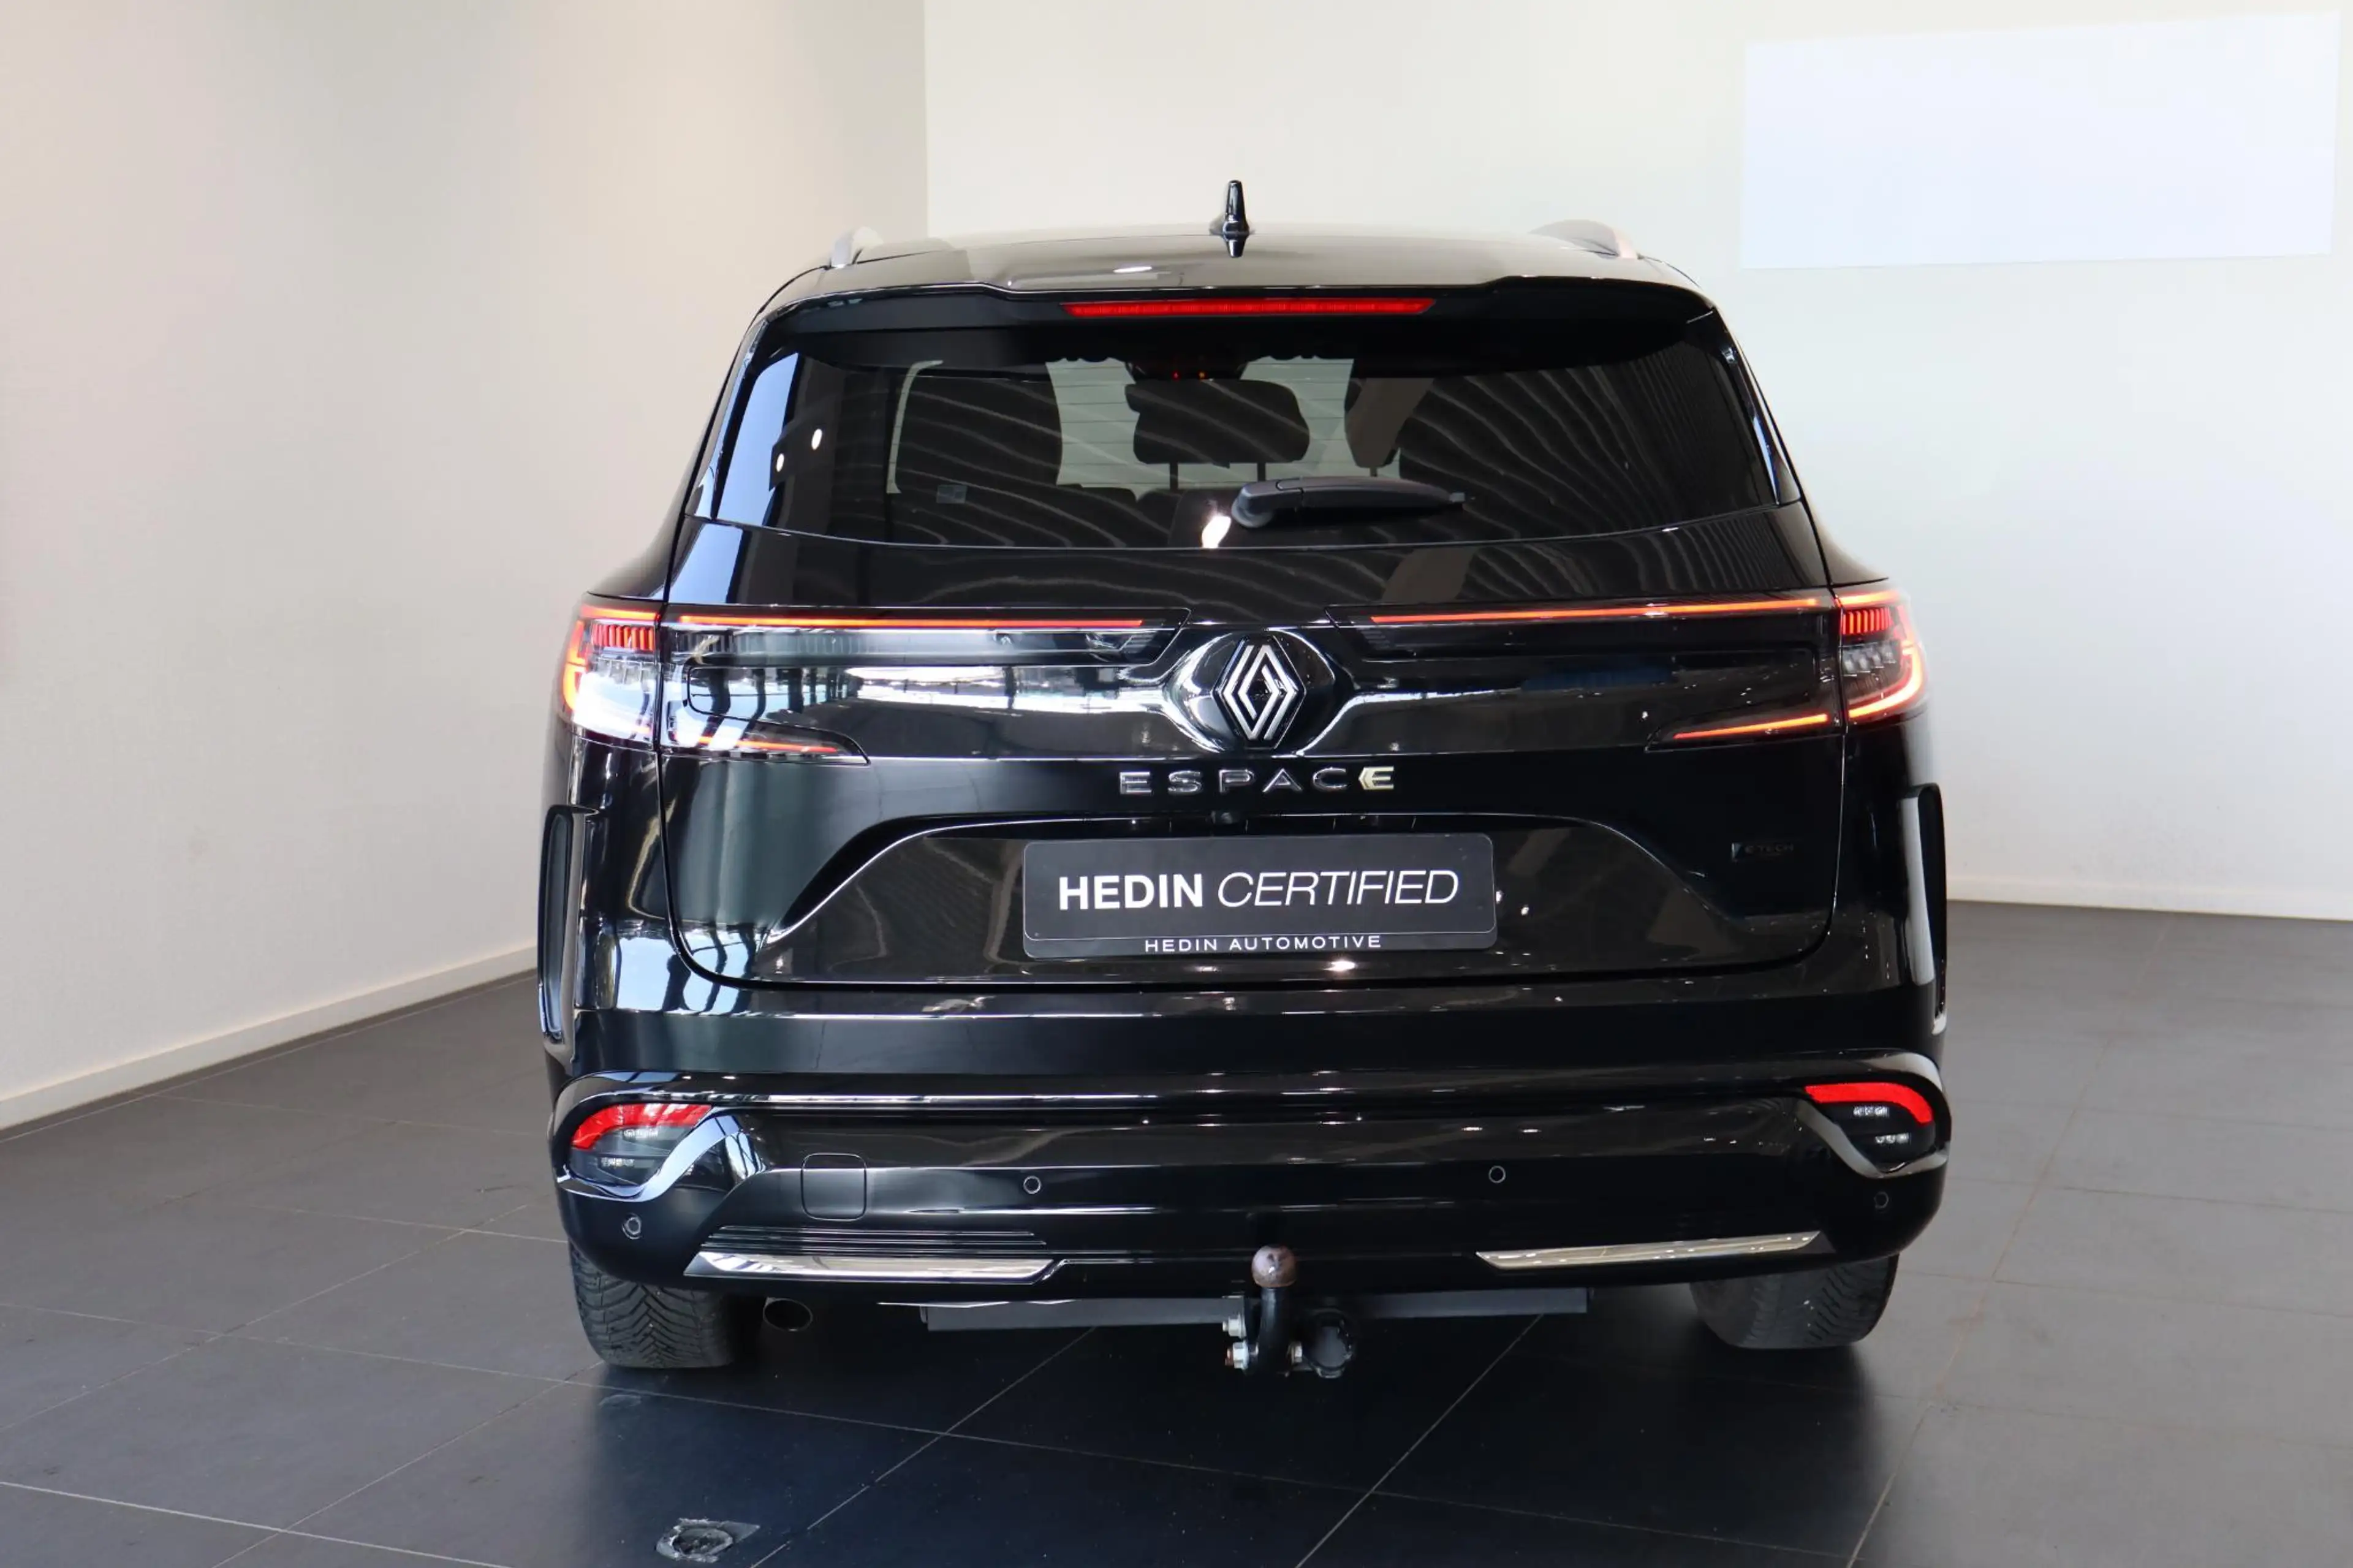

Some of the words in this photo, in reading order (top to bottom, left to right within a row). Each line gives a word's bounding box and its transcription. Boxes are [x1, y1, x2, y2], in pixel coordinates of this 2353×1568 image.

[1120, 767, 1395, 795] ESPACE
[1059, 873, 1203, 911] HEDIN
[1218, 869, 1460, 907] CERTIFIED
[1145, 937, 1218, 953] HEDIN
[1229, 934, 1382, 951] AUTOMOTIVE
